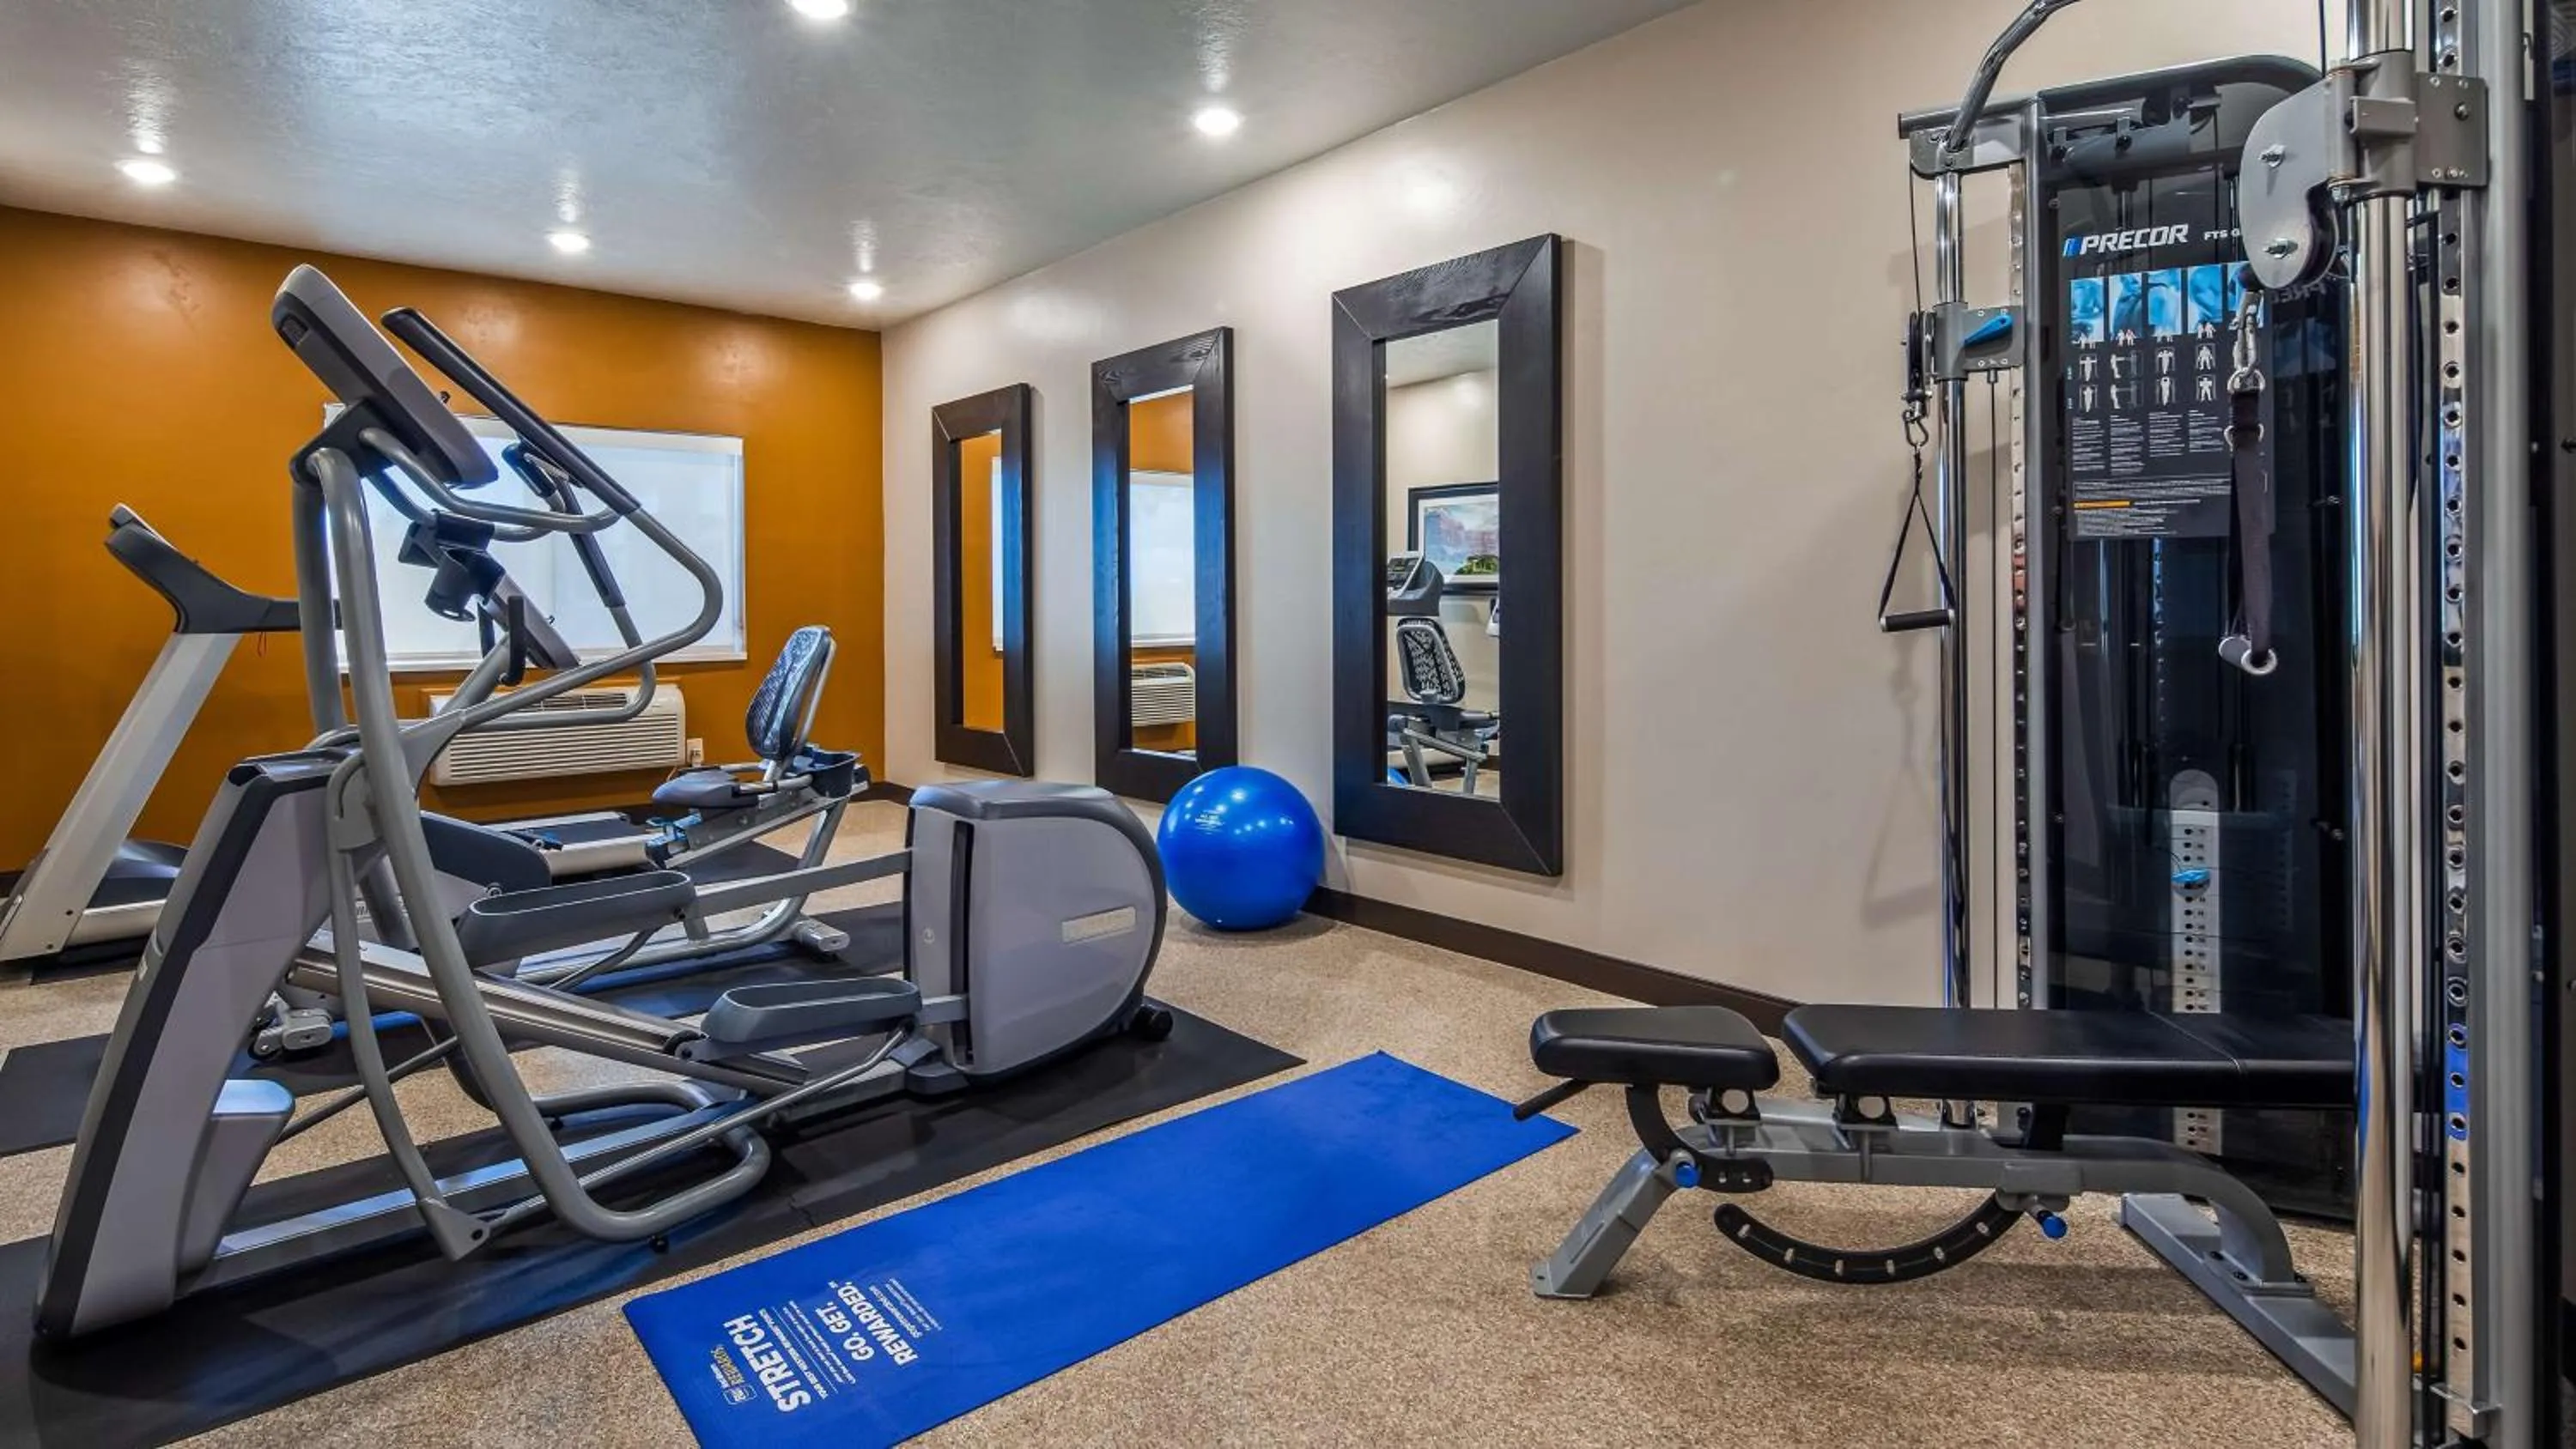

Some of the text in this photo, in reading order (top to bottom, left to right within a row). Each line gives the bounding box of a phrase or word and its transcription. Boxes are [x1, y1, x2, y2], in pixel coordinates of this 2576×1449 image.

[2079, 223, 2189, 256] PRECOR
[2203, 229, 2228, 241] FTS
[816, 1301, 853, 1333] GET.
[842, 1331, 875, 1361] GO.
[723, 1313, 811, 1412] STRETCH
